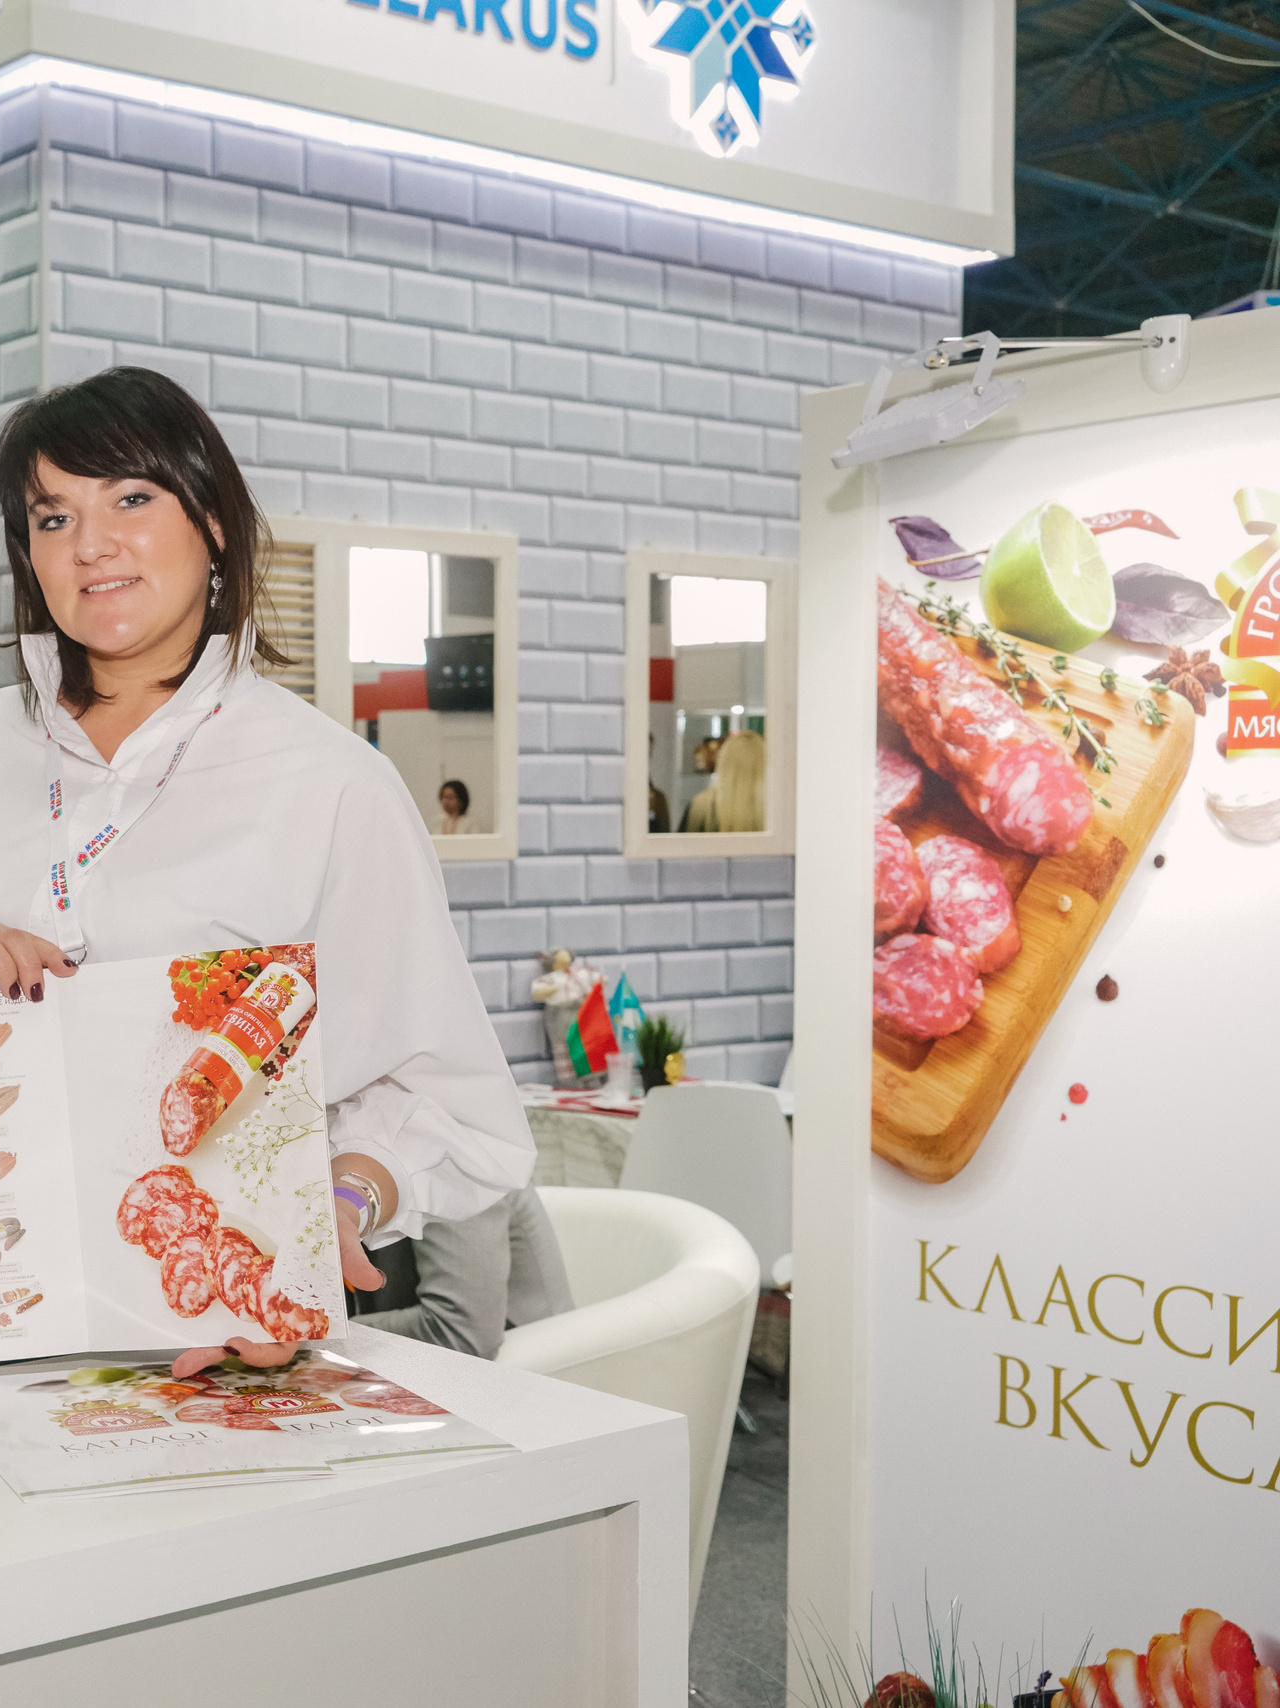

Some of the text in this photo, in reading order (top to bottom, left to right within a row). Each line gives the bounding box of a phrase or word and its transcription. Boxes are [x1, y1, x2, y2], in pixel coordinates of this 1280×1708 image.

[103, 824, 113, 833] IN
[89, 828, 120, 859] BELARUS
[58, 861, 68, 895] BELARUS
[223, 1013, 267, 1049] СВИНАЯ
[282, 1415, 387, 1433] ТАЛОГ
[60, 1429, 210, 1453] КАТАЛОГ
